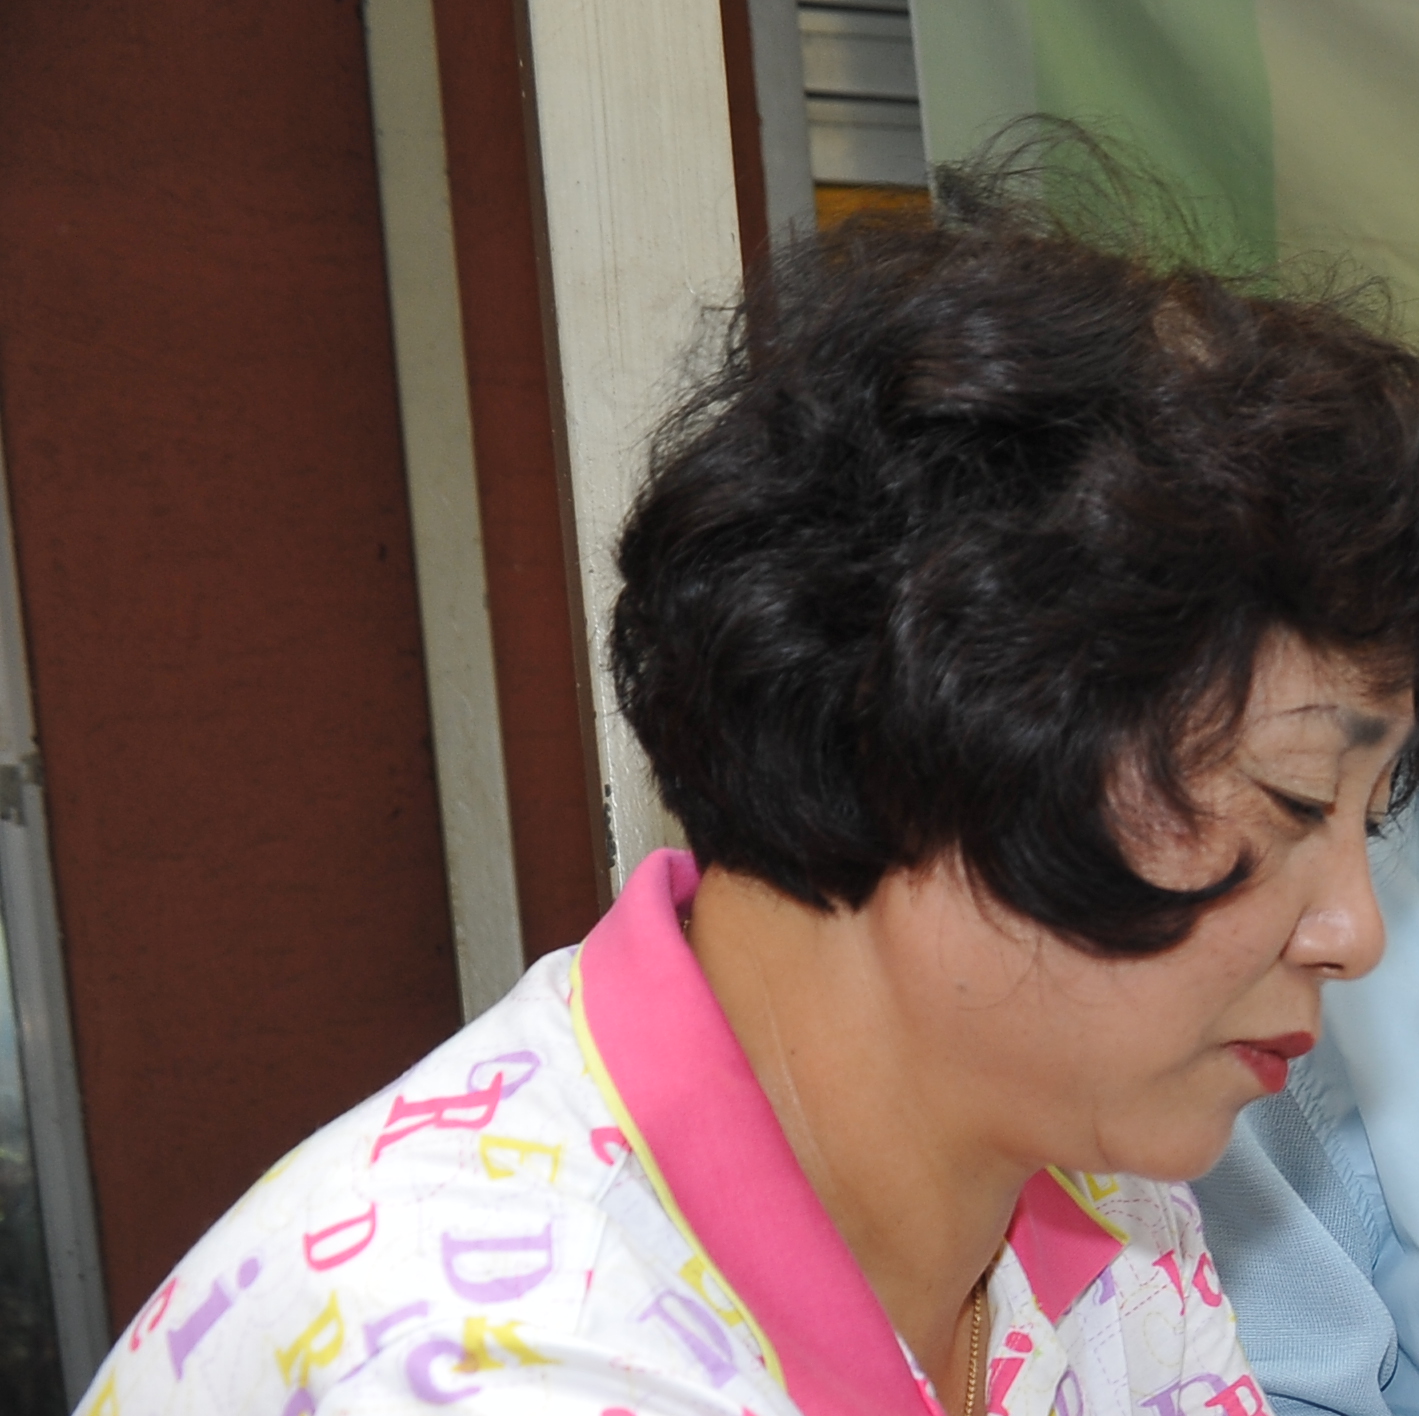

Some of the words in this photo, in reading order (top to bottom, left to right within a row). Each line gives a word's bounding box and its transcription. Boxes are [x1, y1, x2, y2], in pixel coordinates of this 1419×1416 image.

[370, 1071, 503, 1168] R
[303, 1201, 377, 1272] D
[442, 1222, 553, 1304] D
